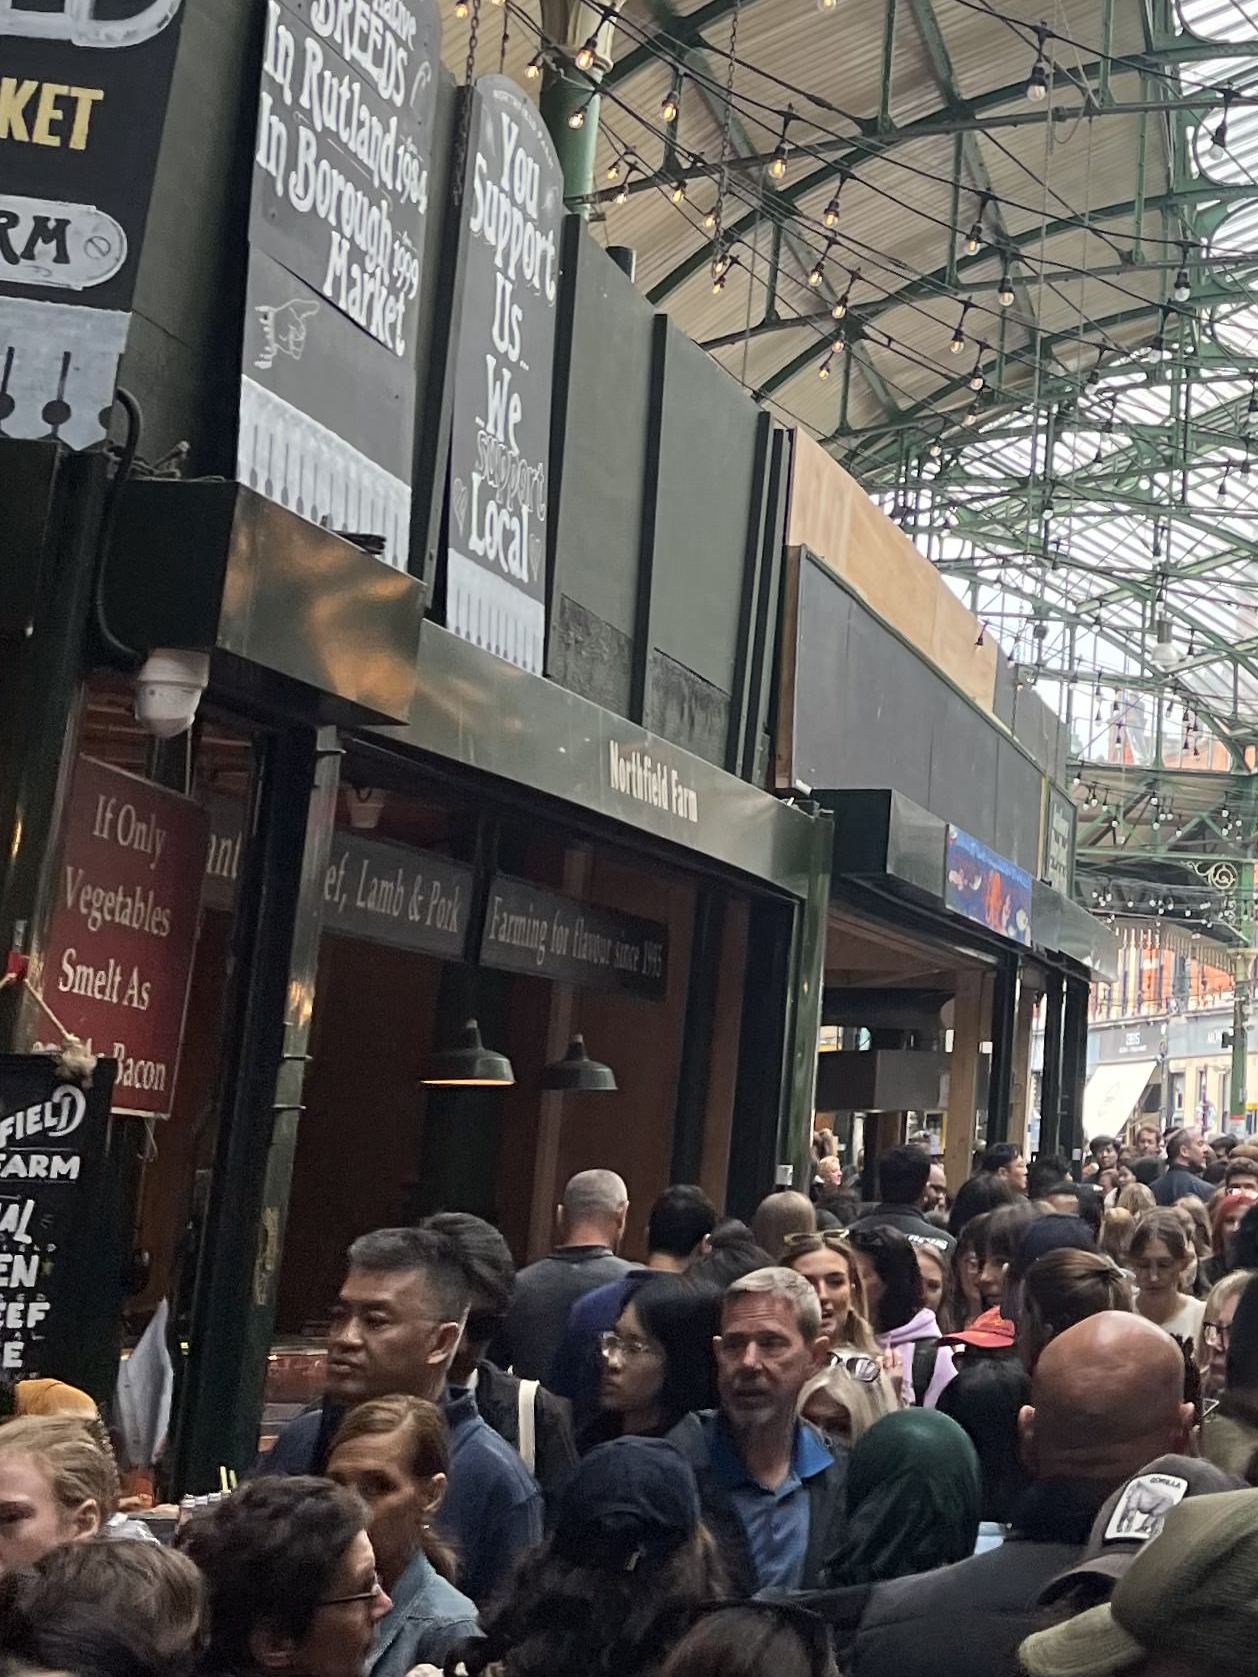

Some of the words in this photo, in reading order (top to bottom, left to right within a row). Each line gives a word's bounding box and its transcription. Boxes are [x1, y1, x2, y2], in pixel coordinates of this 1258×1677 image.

[0, 77, 105, 150] KET
[263, 0, 295, 106] In
[299, 37, 399, 191] Rutland
[395, 144, 428, 214] 1984
[255, 91, 288, 198] In
[288, 125, 393, 286] Borough
[391, 240, 419, 300] 1999
[500, 112, 540, 220] You
[470, 152, 556, 302] Support
[323, 231, 406, 357] Market
[468, 472, 529, 583] Local
[610, 739, 669, 811] Northfield
[671, 769, 698, 823] Farm
[93, 793, 117, 840] If
[117, 804, 168, 870] Only
[65, 865, 172, 938] Vegetables
[356, 859, 405, 918] Lamb
[408, 874, 424, 923] &
[425, 880, 462, 934] Pork
[488, 895, 549, 966] Farming
[550, 908, 570, 956] for
[58, 947, 122, 1005] Smelt
[122, 965, 151, 1011] As
